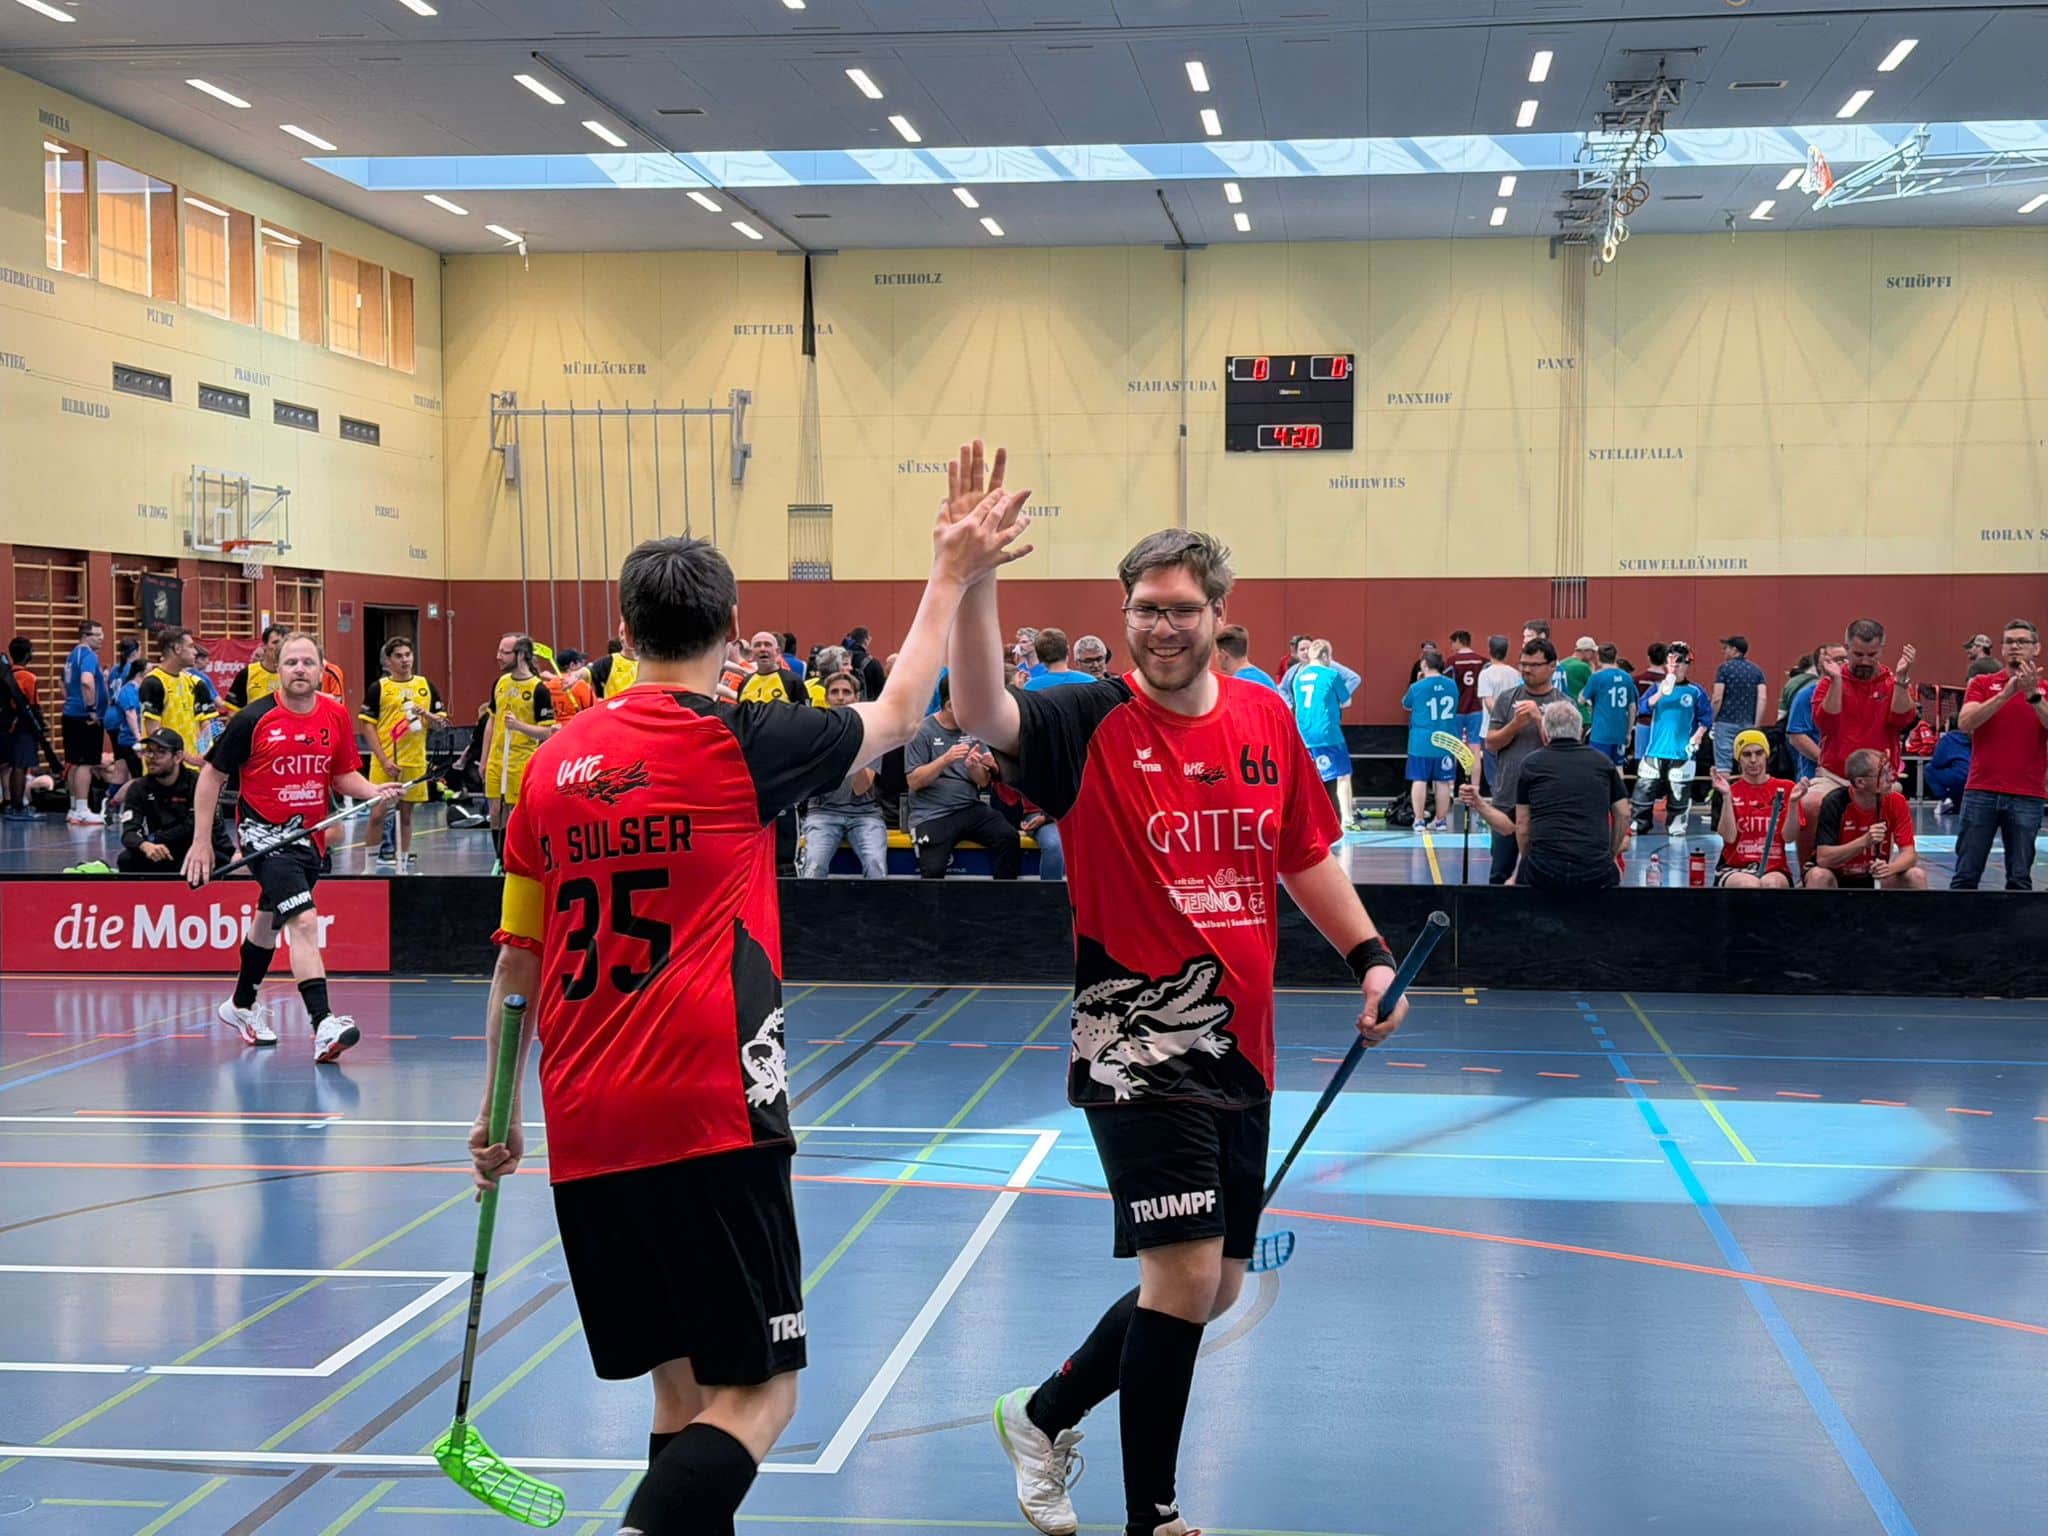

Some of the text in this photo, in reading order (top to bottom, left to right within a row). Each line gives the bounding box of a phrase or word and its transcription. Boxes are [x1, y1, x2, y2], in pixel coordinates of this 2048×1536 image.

[874, 273, 943, 285] EICHHOLZ
[1886, 273, 1952, 288] SCHÖPFI
[733, 325, 794, 335] BETTLER
[563, 360, 647, 375] MÜHLÄCKER
[1254, 358, 1268, 379] 0
[1332, 357, 1346, 378] 0
[1328, 475, 1406, 489] MÖHRWIES
[1981, 529, 2033, 541] ROHAN
[1463, 671, 1474, 686] 6
[1300, 684, 1315, 708] 7
[1608, 686, 1628, 708] 13
[1426, 695, 1455, 720] 12
[320, 728, 330, 747] 2
[272, 754, 332, 775] GRITEC
[1239, 744, 1279, 786] 66
[567, 815, 692, 864] SULSER
[1147, 808, 1274, 853] GRITEC
[54, 903, 334, 949] die Mobir
[557, 867, 672, 1001] 35
[1130, 1190, 1217, 1224] TRUMPF
[769, 1310, 807, 1343] TRU
